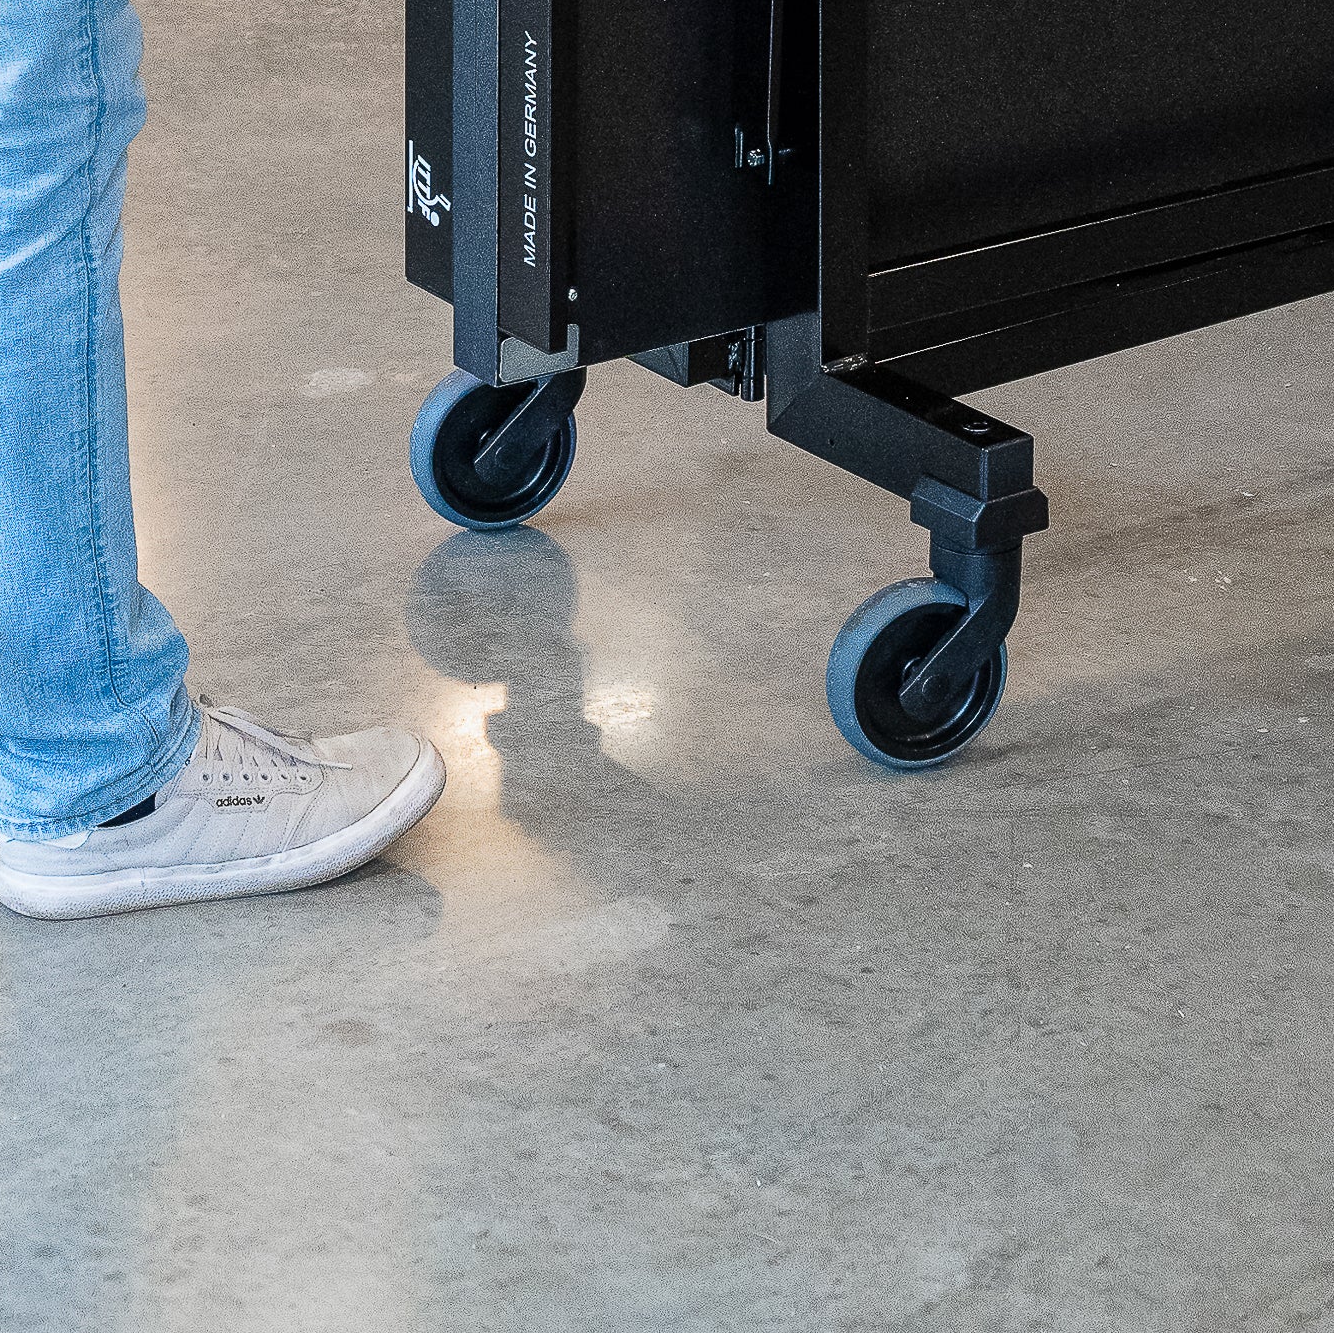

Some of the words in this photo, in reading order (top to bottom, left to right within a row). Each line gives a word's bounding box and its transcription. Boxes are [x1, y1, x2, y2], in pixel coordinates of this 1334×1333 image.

[524, 30, 539, 159] GERMANY
[524, 162, 536, 189] IN
[523, 193, 536, 267] MADE
[215, 795, 253, 808] adidas
